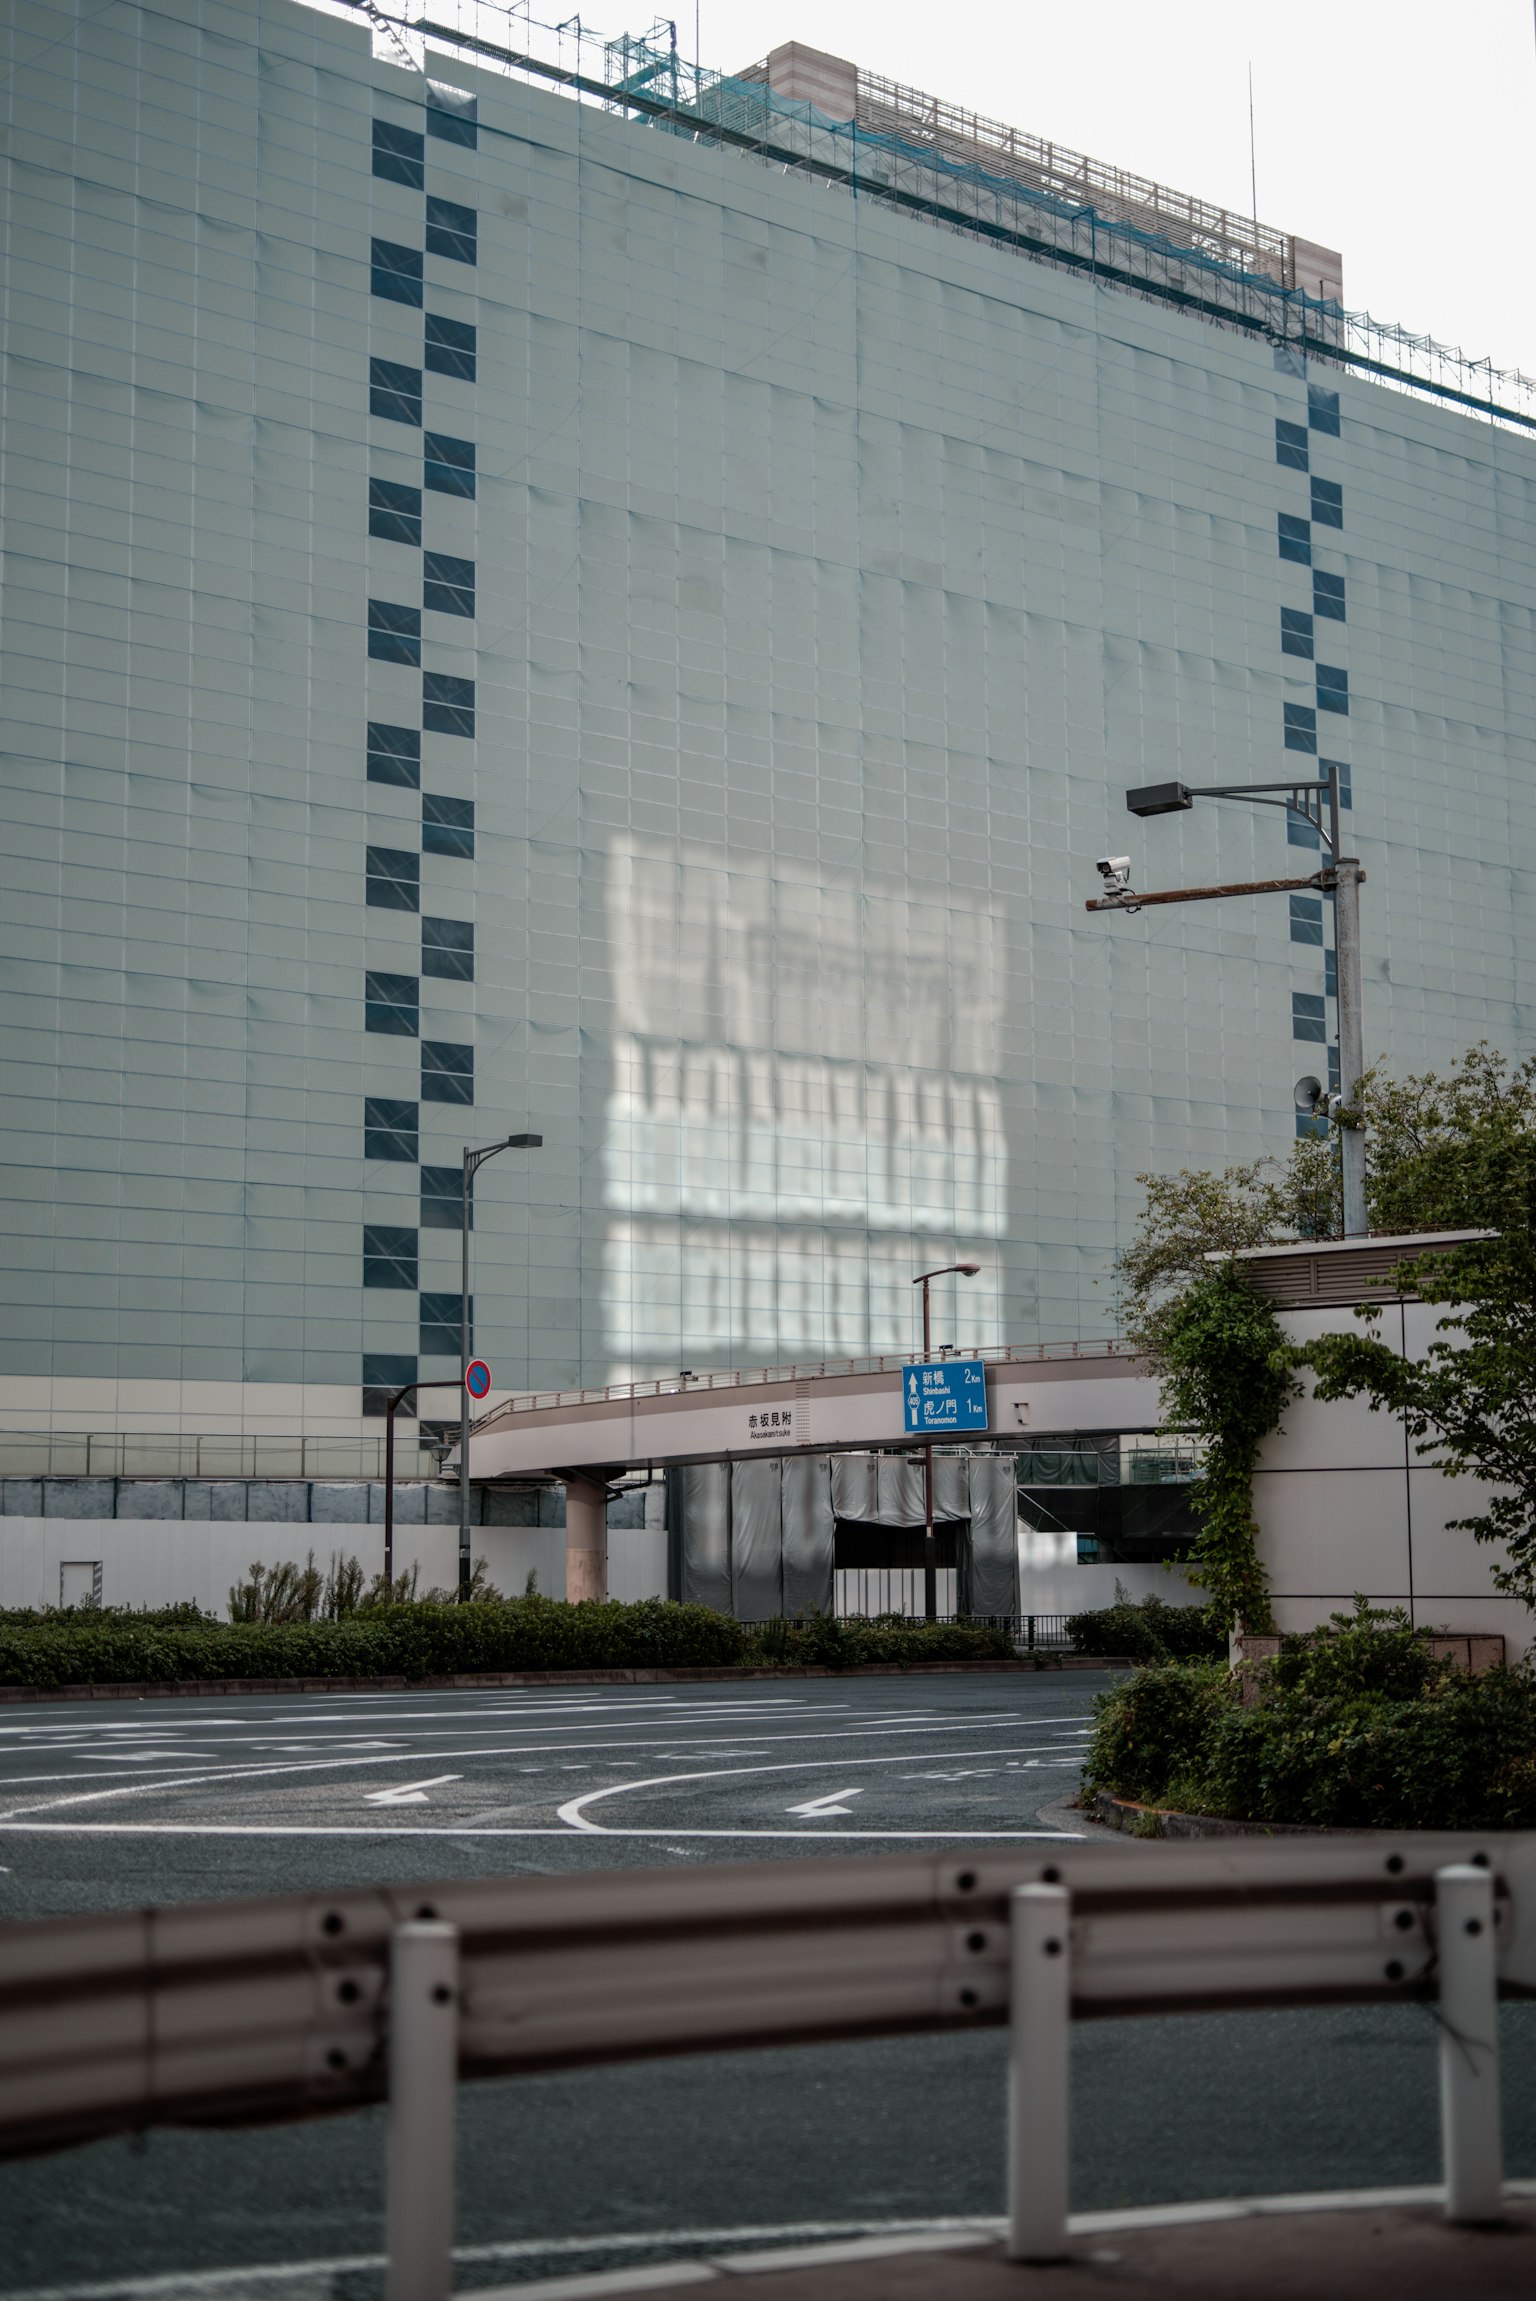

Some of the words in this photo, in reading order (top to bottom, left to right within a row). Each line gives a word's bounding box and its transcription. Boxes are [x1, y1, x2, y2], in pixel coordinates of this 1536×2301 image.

[922, 1370, 945, 1386] 新橋
[923, 1386, 951, 1396] Shinbashi
[924, 1399, 957, 1416] 虎ノ門
[748, 1411, 792, 1428] 赤坂見附
[924, 1416, 957, 1425] Toranomon
[750, 1429, 791, 1439] Akasakamitsuke
